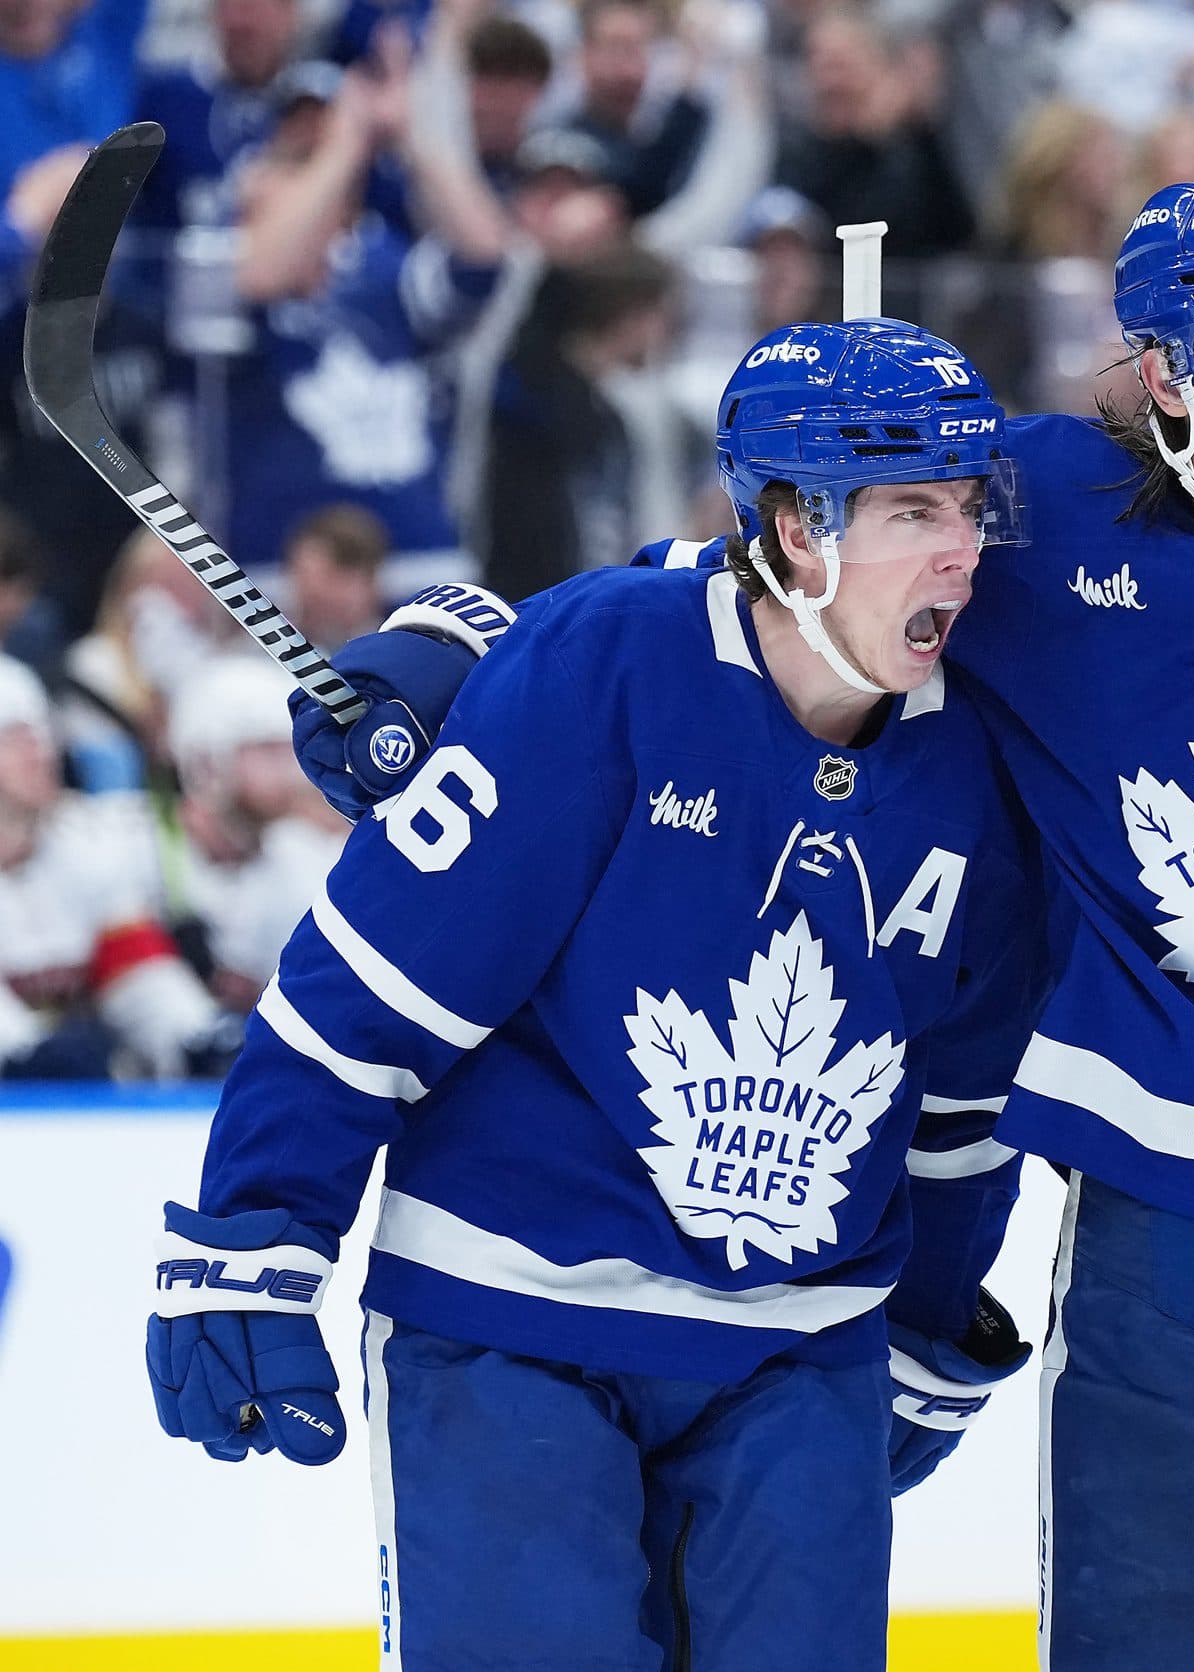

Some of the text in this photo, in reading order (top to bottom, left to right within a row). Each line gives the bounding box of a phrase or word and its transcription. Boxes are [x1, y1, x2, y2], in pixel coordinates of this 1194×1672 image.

[745, 343, 821, 369] OREO
[921, 357, 970, 387] 16
[939, 418, 996, 436] CCM
[1067, 563, 1147, 610] Milk
[821, 770, 848, 788] NHL
[649, 780, 719, 837] Milk
[876, 846, 968, 958] A
[673, 1075, 853, 1145] TORONTO
[695, 1118, 821, 1169] MAPLE
[685, 1157, 810, 1206] LEAFS
[281, 1402, 336, 1437] TRUE
[379, 1544, 391, 1654] CCM
